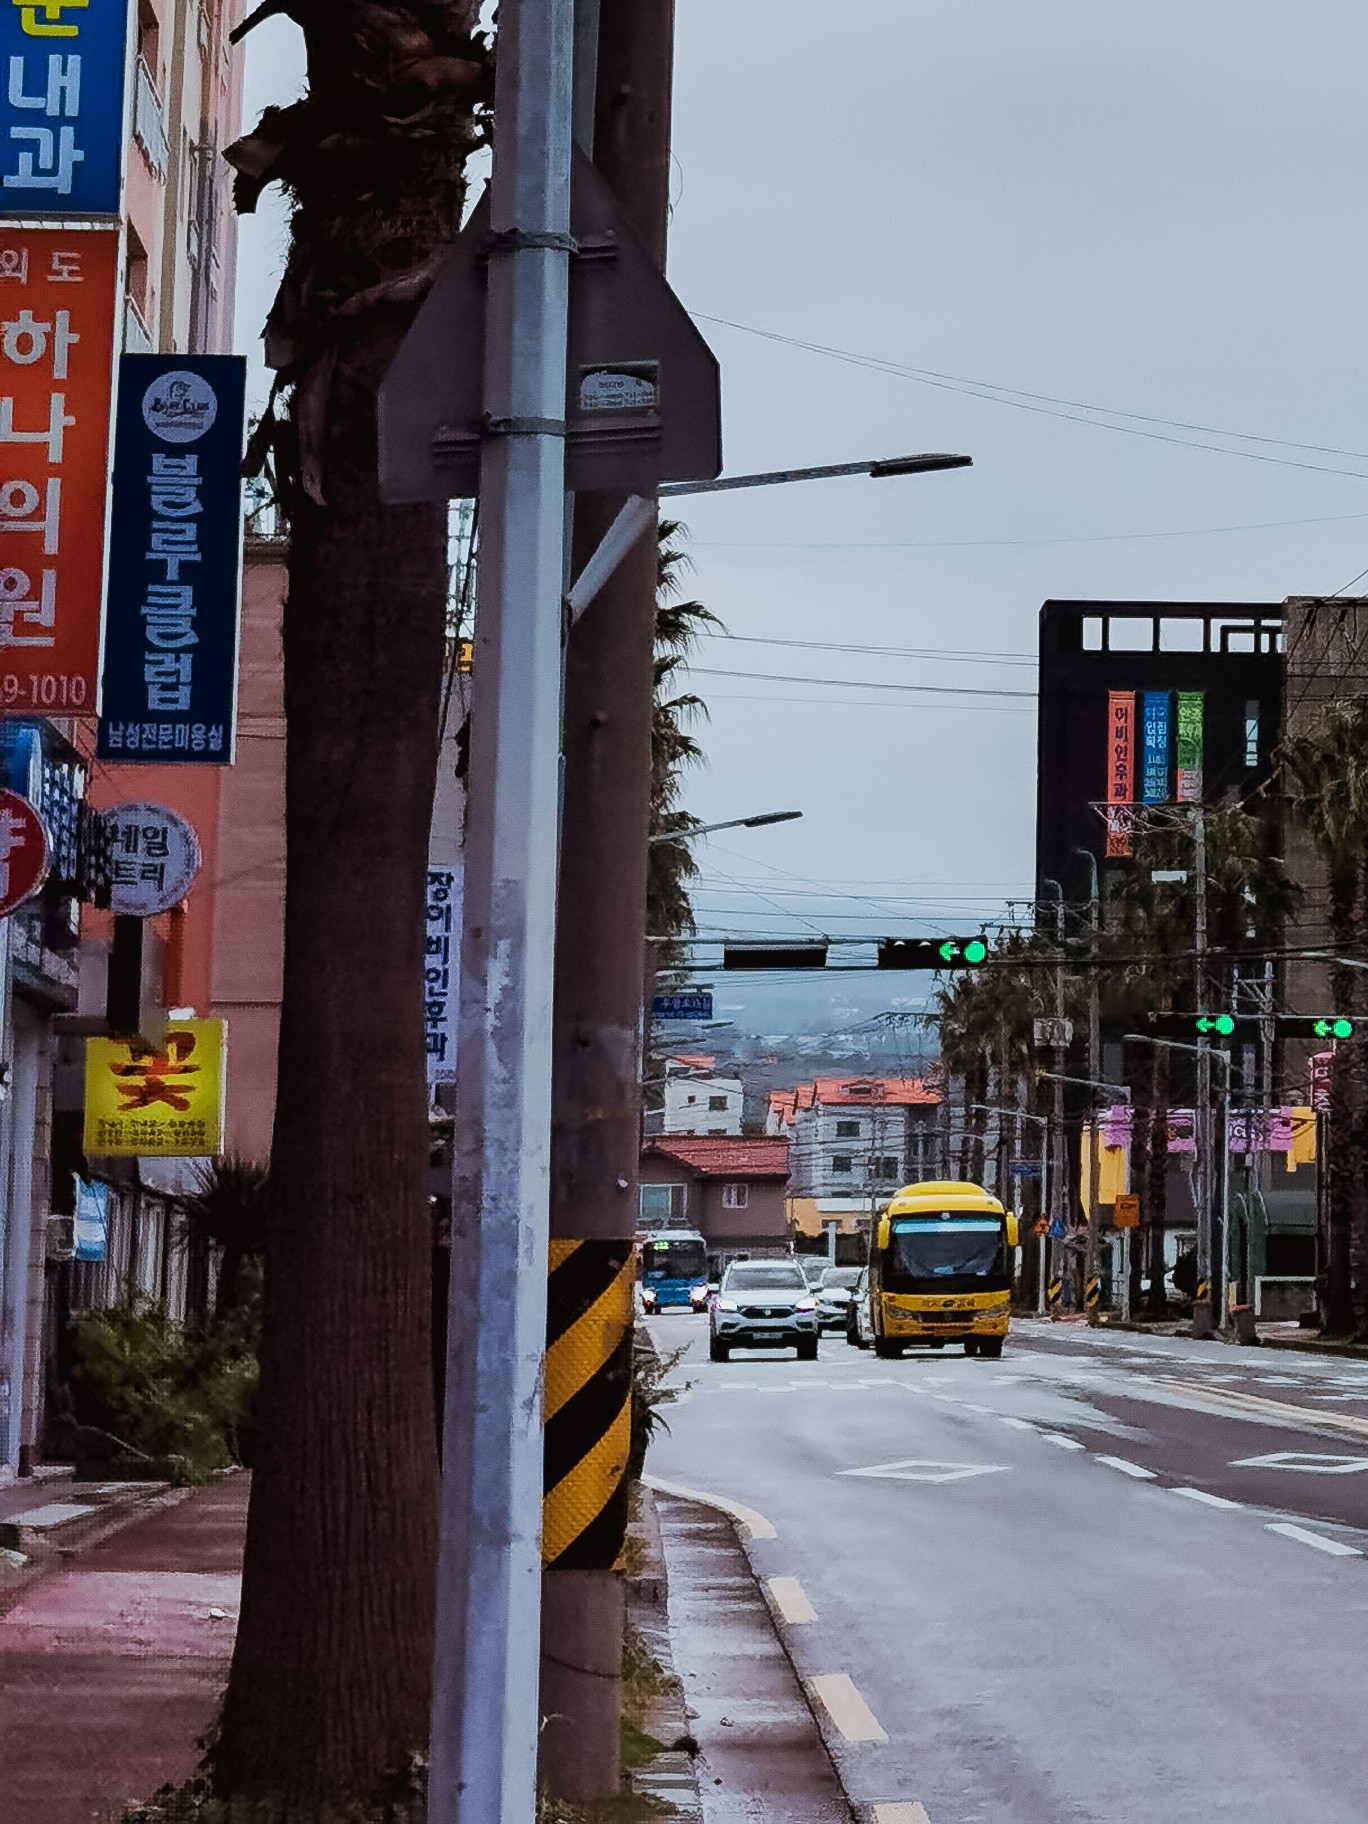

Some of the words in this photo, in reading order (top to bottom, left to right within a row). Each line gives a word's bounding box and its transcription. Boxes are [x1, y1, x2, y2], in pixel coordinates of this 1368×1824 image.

[2, 54, 84, 194] 내과
[0, 247, 84, 286] 외도
[0, 308, 80, 647] 하나의원
[140, 453, 203, 711] 블루클럽
[108, 721, 223, 752] 남성전문미용실
